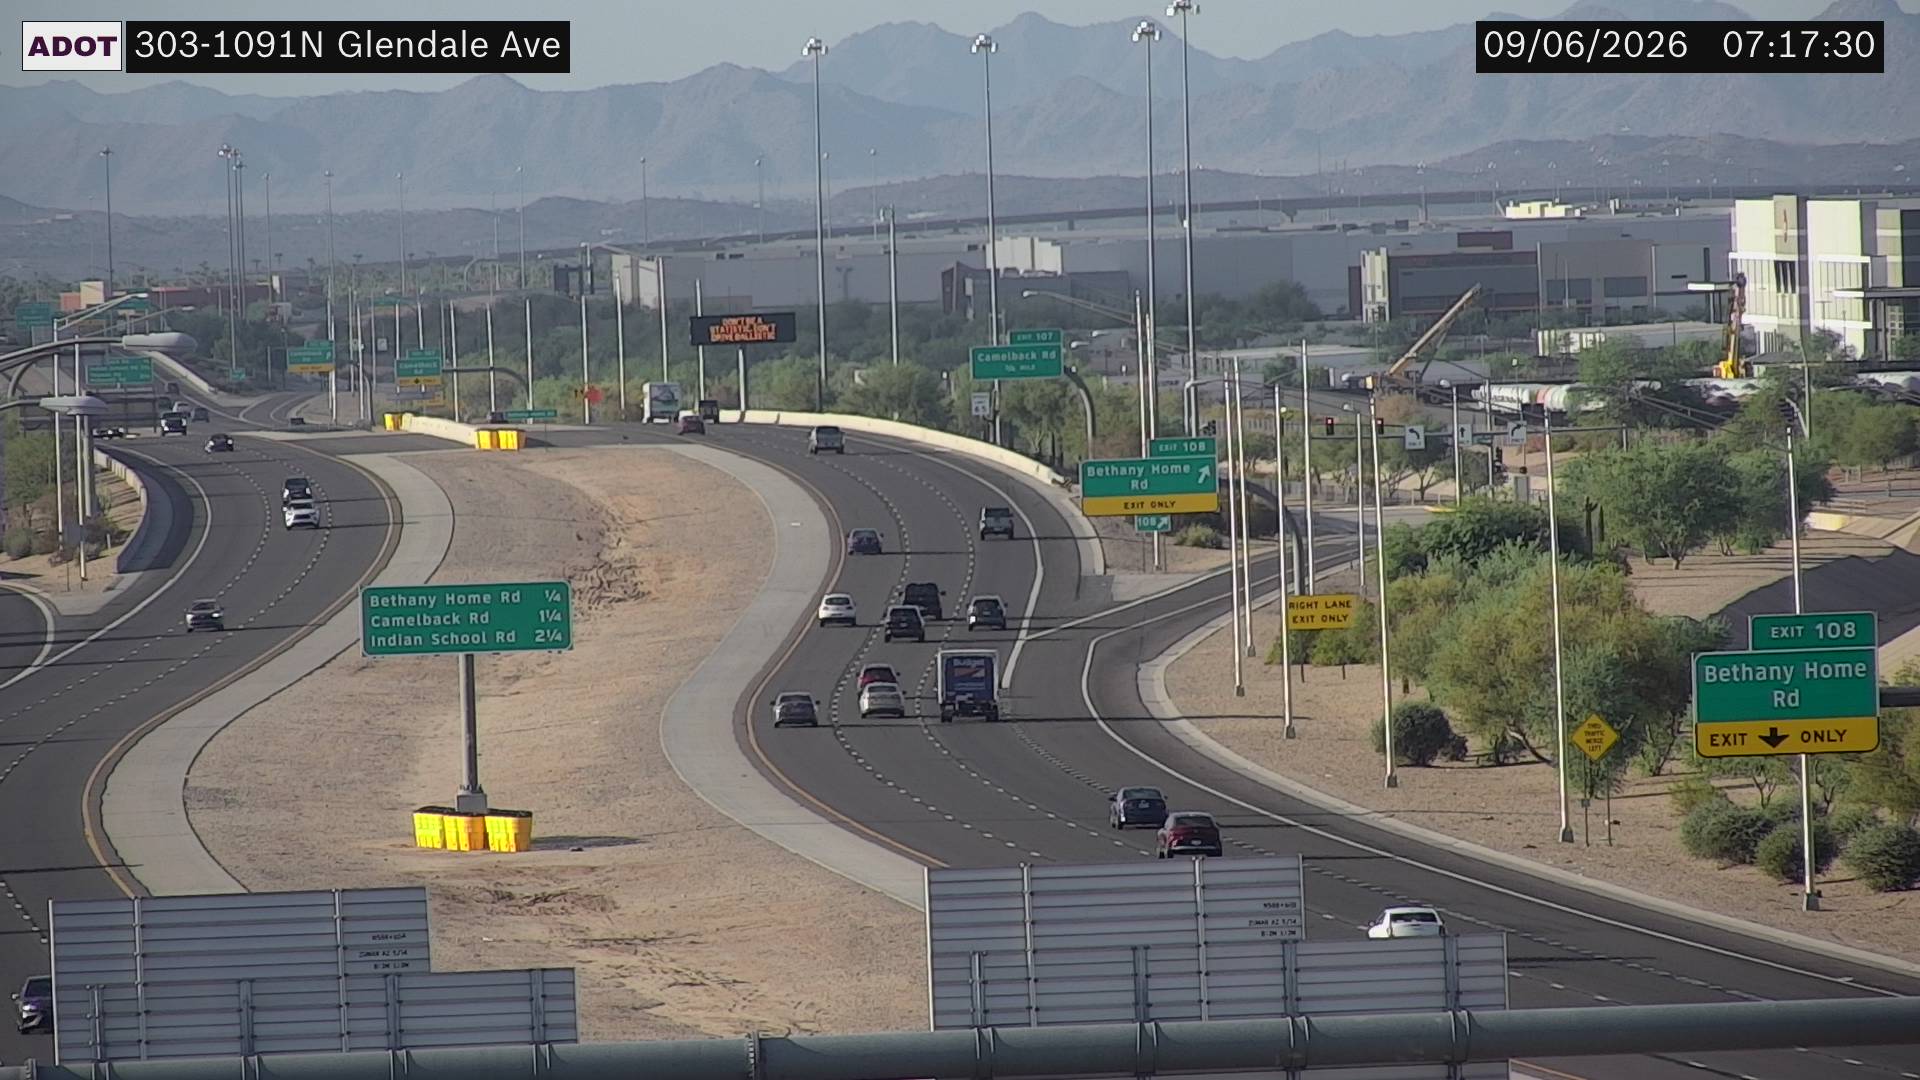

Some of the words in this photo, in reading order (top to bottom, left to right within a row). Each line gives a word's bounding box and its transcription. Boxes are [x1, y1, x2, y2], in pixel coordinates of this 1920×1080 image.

[1036, 332, 1054, 340] 107
[977, 351, 1037, 362] Camelback
[1042, 350, 1057, 360] Rd
[1159, 443, 1177, 451] EXIT
[1183, 442, 1206, 451] 108
[1087, 465, 1145, 478] Bethany
[1151, 463, 1191, 474] Home
[1131, 479, 1149, 490] Rd
[1123, 502, 1145, 510] EXIT
[1150, 501, 1176, 509] ONLY
[370, 594, 437, 609] Bethany
[445, 592, 491, 605] Home
[501, 591, 521, 603] Rd
[1289, 601, 1319, 610] RIGHT
[1325, 600, 1352, 609] LANE
[371, 612, 461, 628] Camelback
[469, 611, 490, 624] Rd
[1292, 615, 1315, 624] EXIT
[1321, 614, 1349, 623] ONLY
[1771, 626, 1804, 639] EXIT
[1815, 622, 1856, 639] 108
[371, 633, 423, 647] Indian
[431, 631, 487, 645] School
[496, 630, 516, 643] Rd
[1704, 663, 1794, 684] Bethany
[1805, 661, 1867, 679] Home
[1772, 689, 1800, 708] Rd
[1710, 733, 1748, 747] EXIT
[1800, 729, 1847, 743] ONLY
